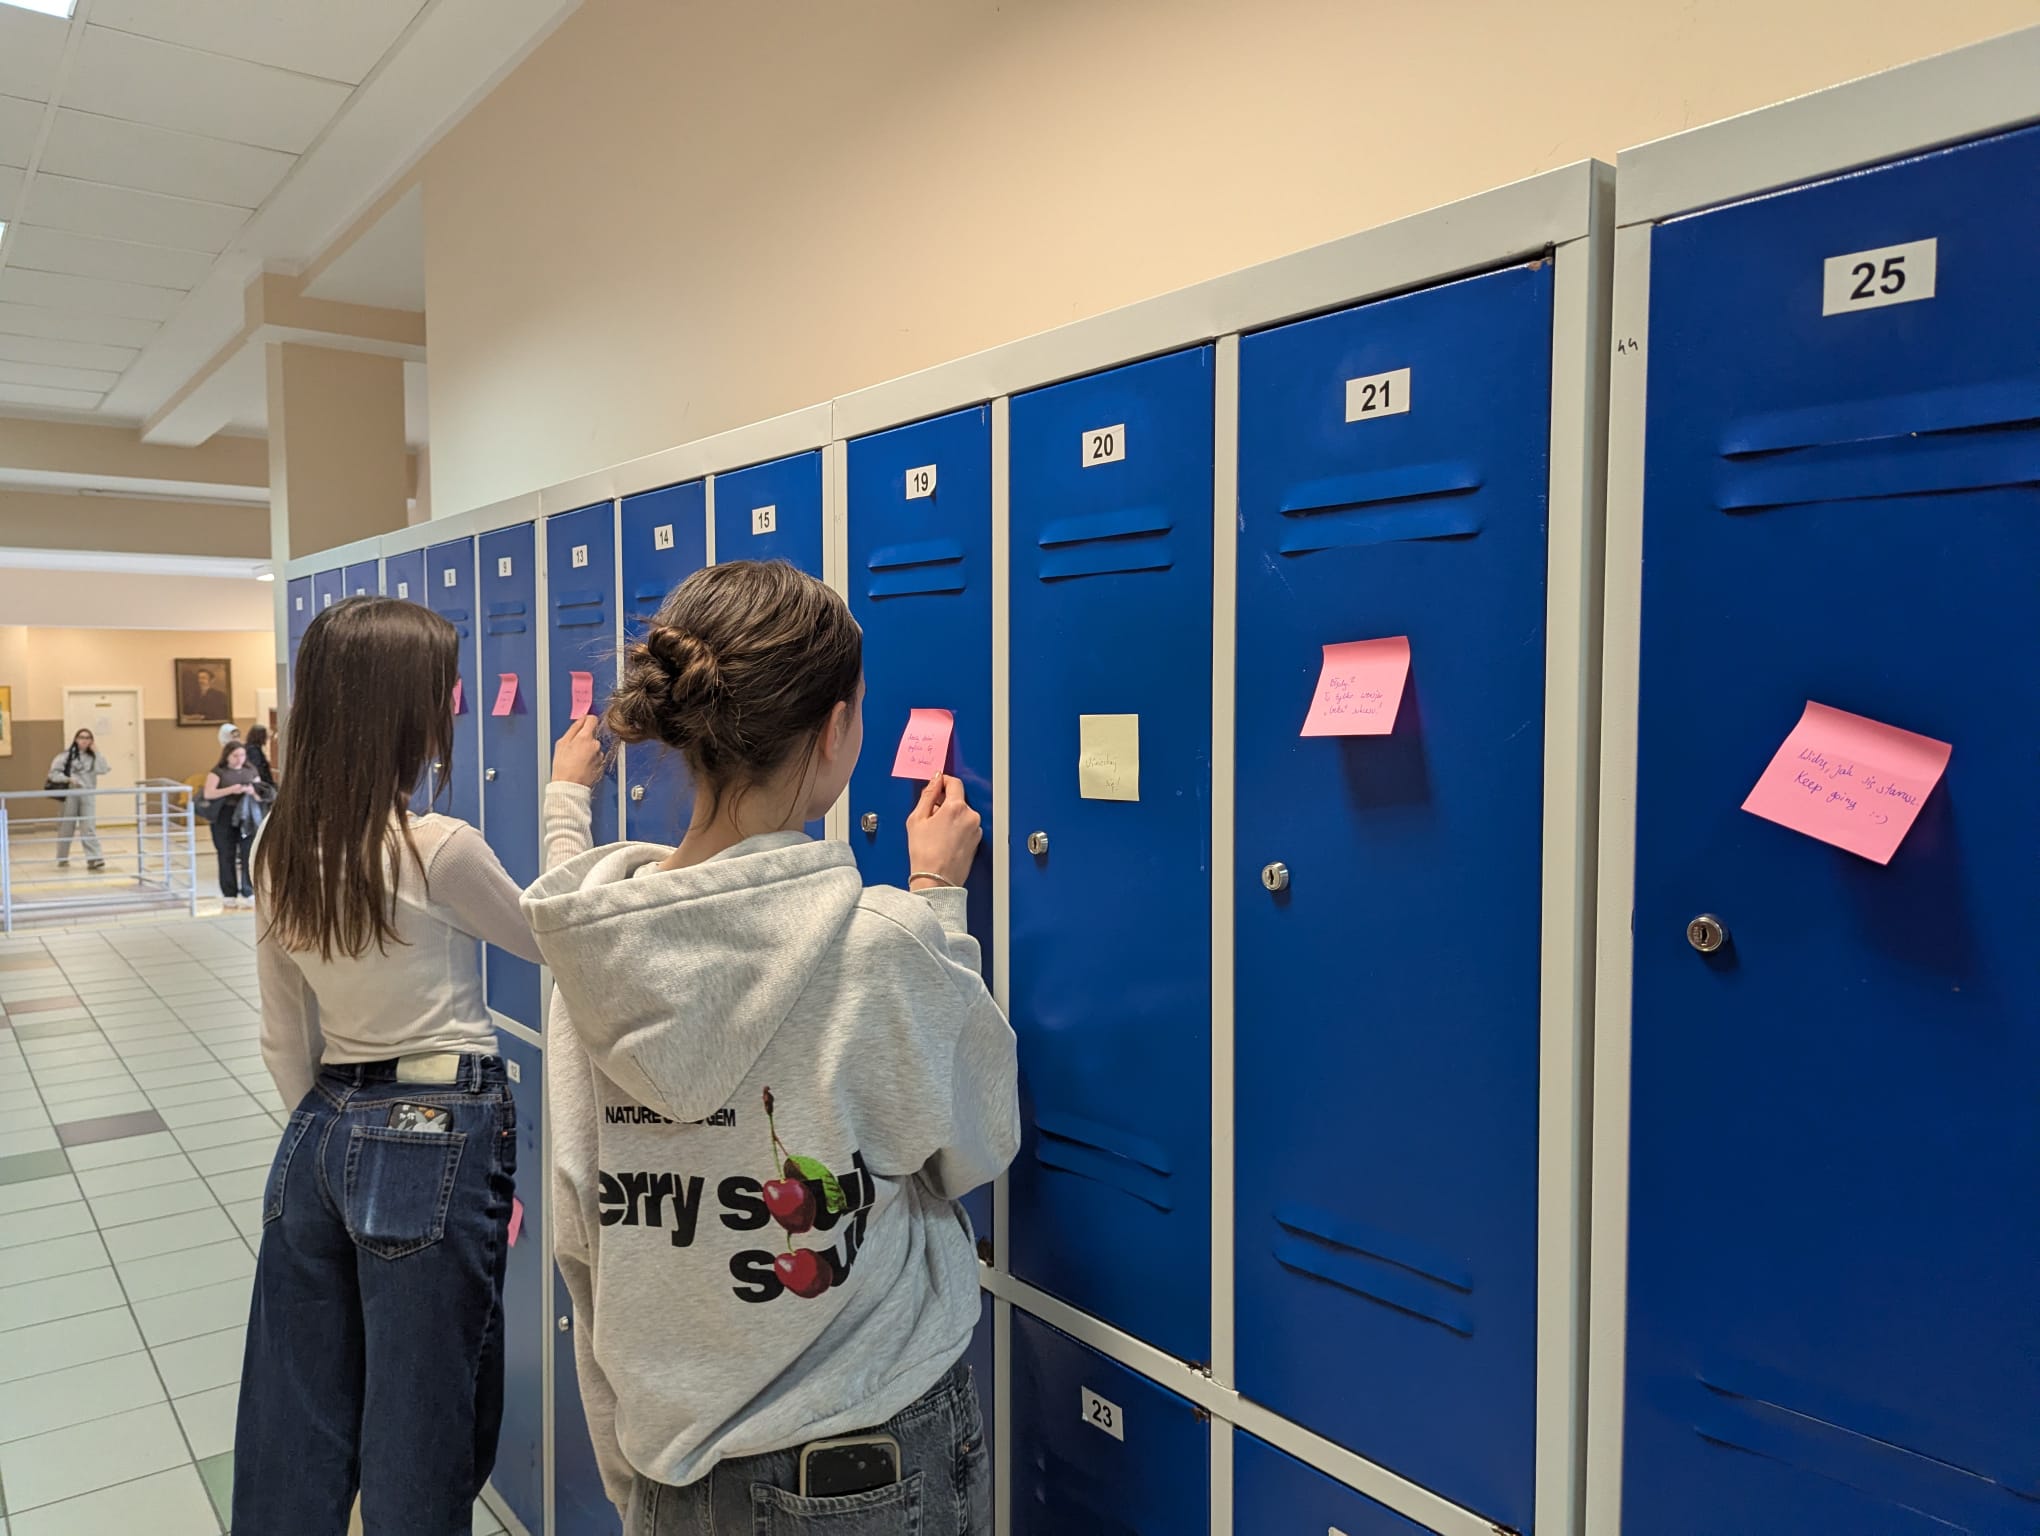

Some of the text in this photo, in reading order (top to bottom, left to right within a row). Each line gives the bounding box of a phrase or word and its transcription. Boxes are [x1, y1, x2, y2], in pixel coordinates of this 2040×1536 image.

[1850, 256, 1906, 301] 25
[1361, 380, 1392, 412] 21
[1092, 433, 1114, 460] 20
[913, 472, 929, 493] 19
[758, 512, 770, 529] 15
[659, 530, 669, 546] 14
[576, 551, 584, 564] 13
[1829, 765, 1853, 779] jak
[1861, 776, 1876, 789] się
[1794, 770, 1823, 794] Keep
[1825, 791, 1857, 811] going
[606, 1106, 673, 1124] NATURE
[599, 1169, 705, 1247] erry
[1092, 1399, 1113, 1429] 23
